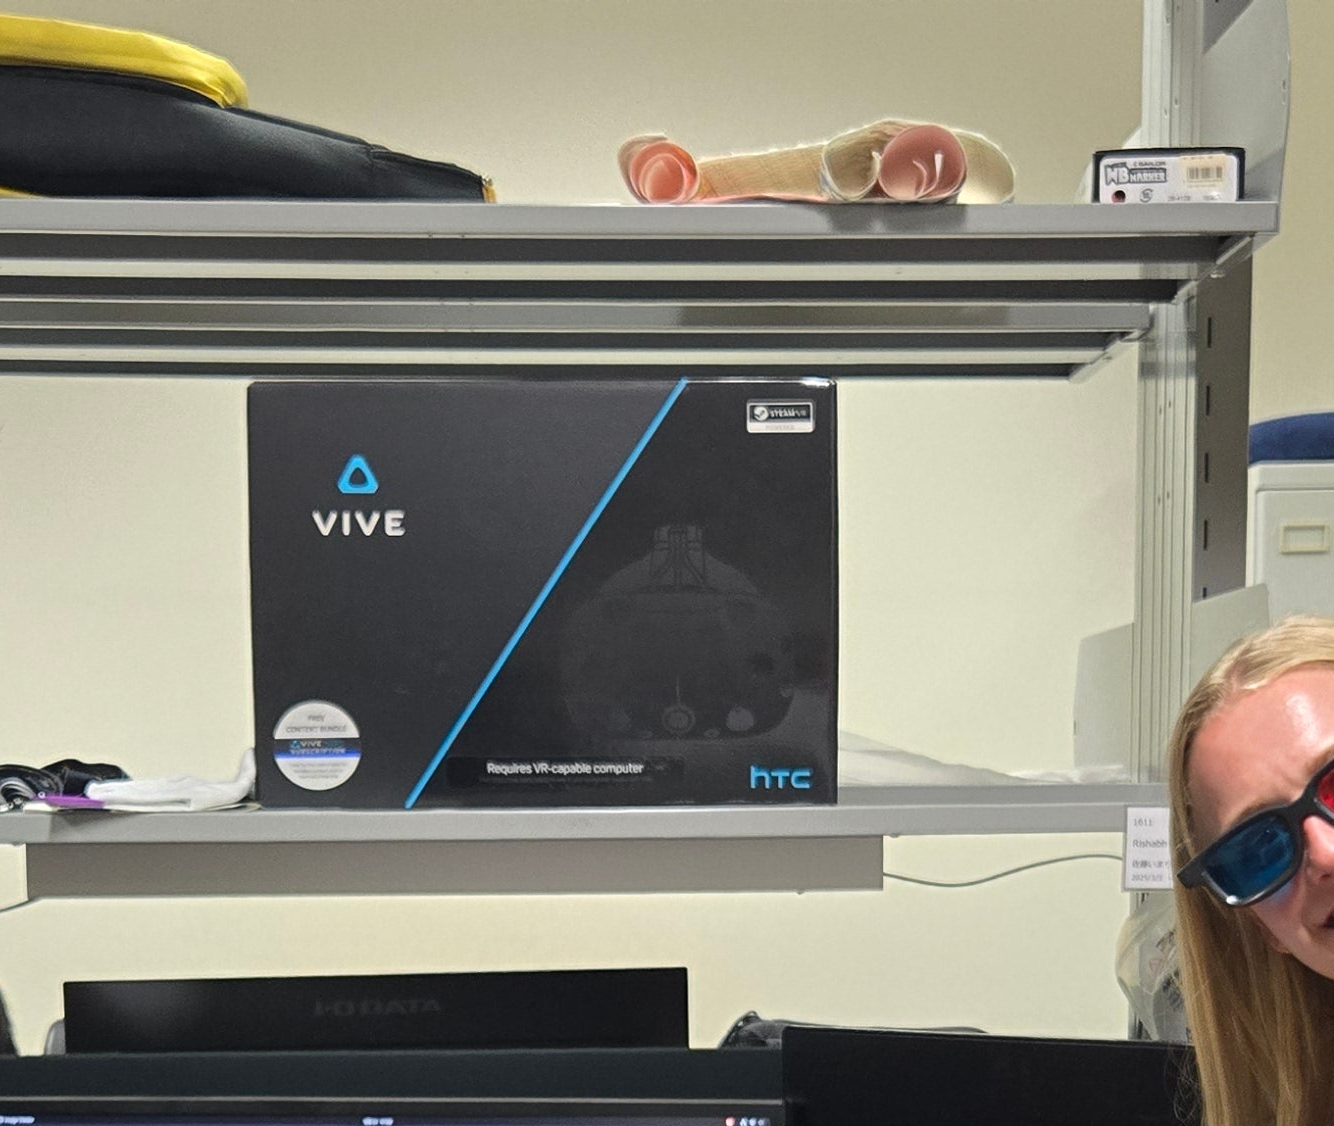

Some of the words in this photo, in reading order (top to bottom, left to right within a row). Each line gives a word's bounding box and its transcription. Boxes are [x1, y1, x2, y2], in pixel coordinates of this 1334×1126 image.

[312, 510, 406, 536] VIVE
[487, 763, 533, 776] Requires
[533, 763, 592, 776] VR-capable
[593, 763, 644, 776] computer
[1133, 818, 1153, 827] 1611
